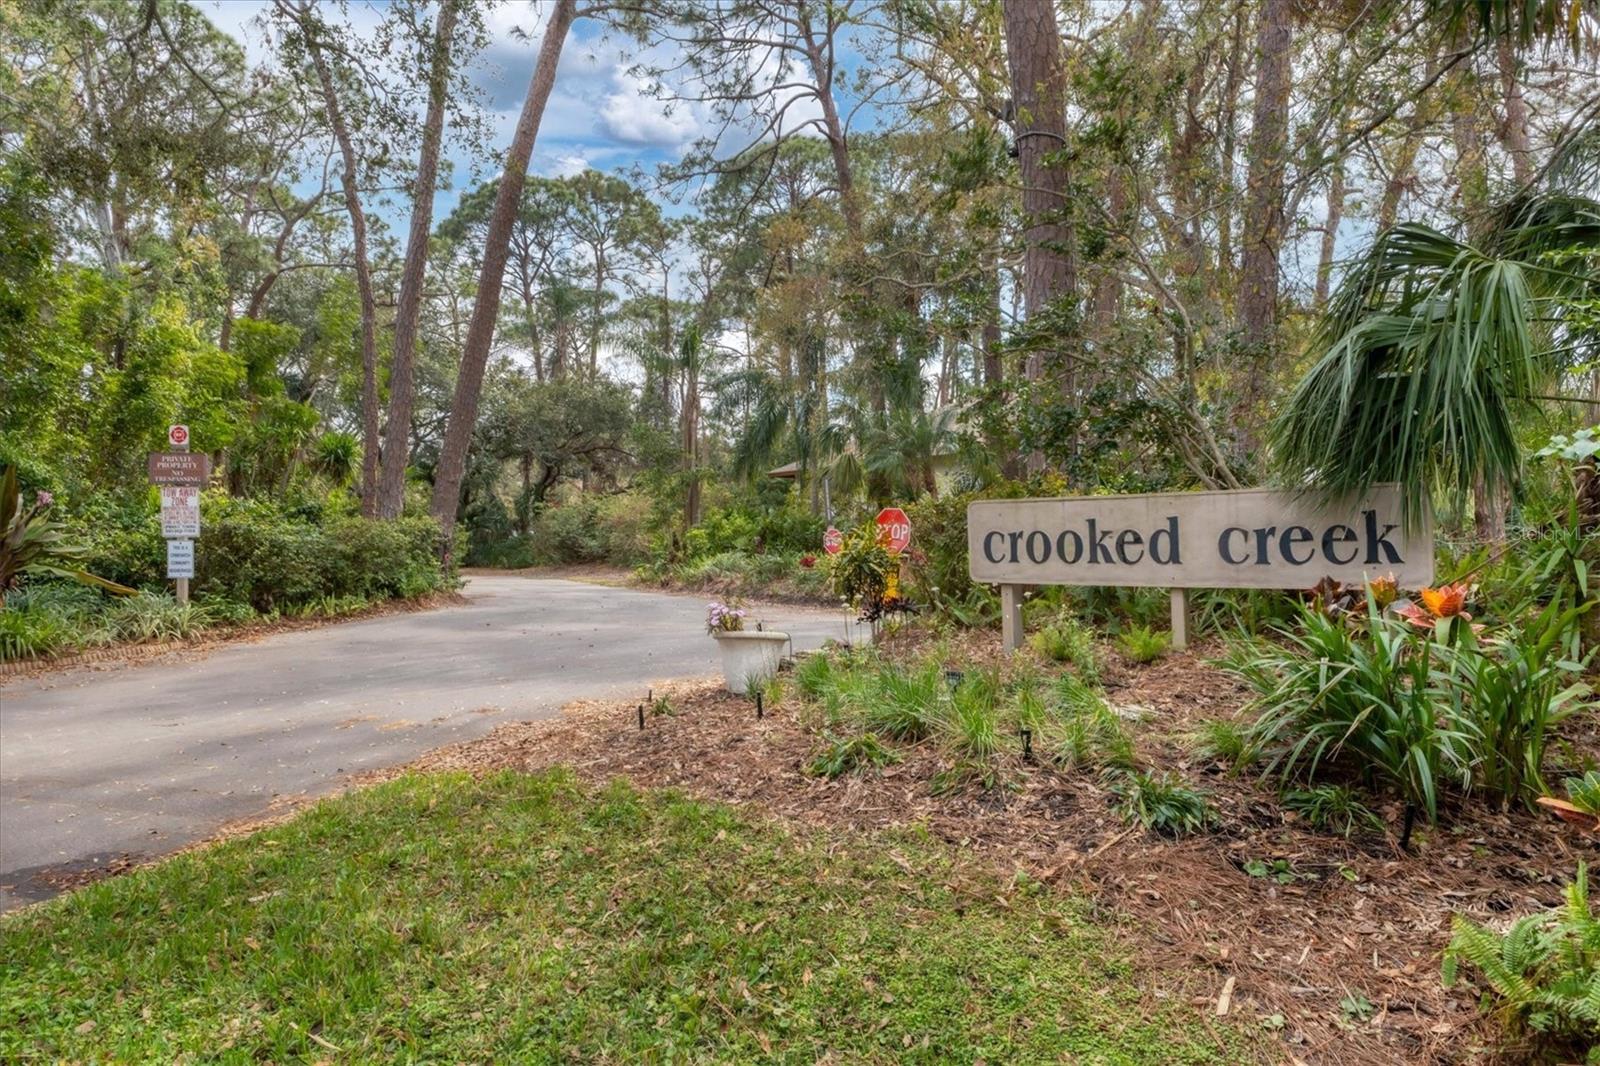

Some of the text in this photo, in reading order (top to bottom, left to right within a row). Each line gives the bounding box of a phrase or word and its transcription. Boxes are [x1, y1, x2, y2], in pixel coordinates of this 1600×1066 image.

[163, 487, 197, 497] TOW AWAY
[171, 496, 188, 506] ZONE
[983, 509, 1405, 566] crooked creek
